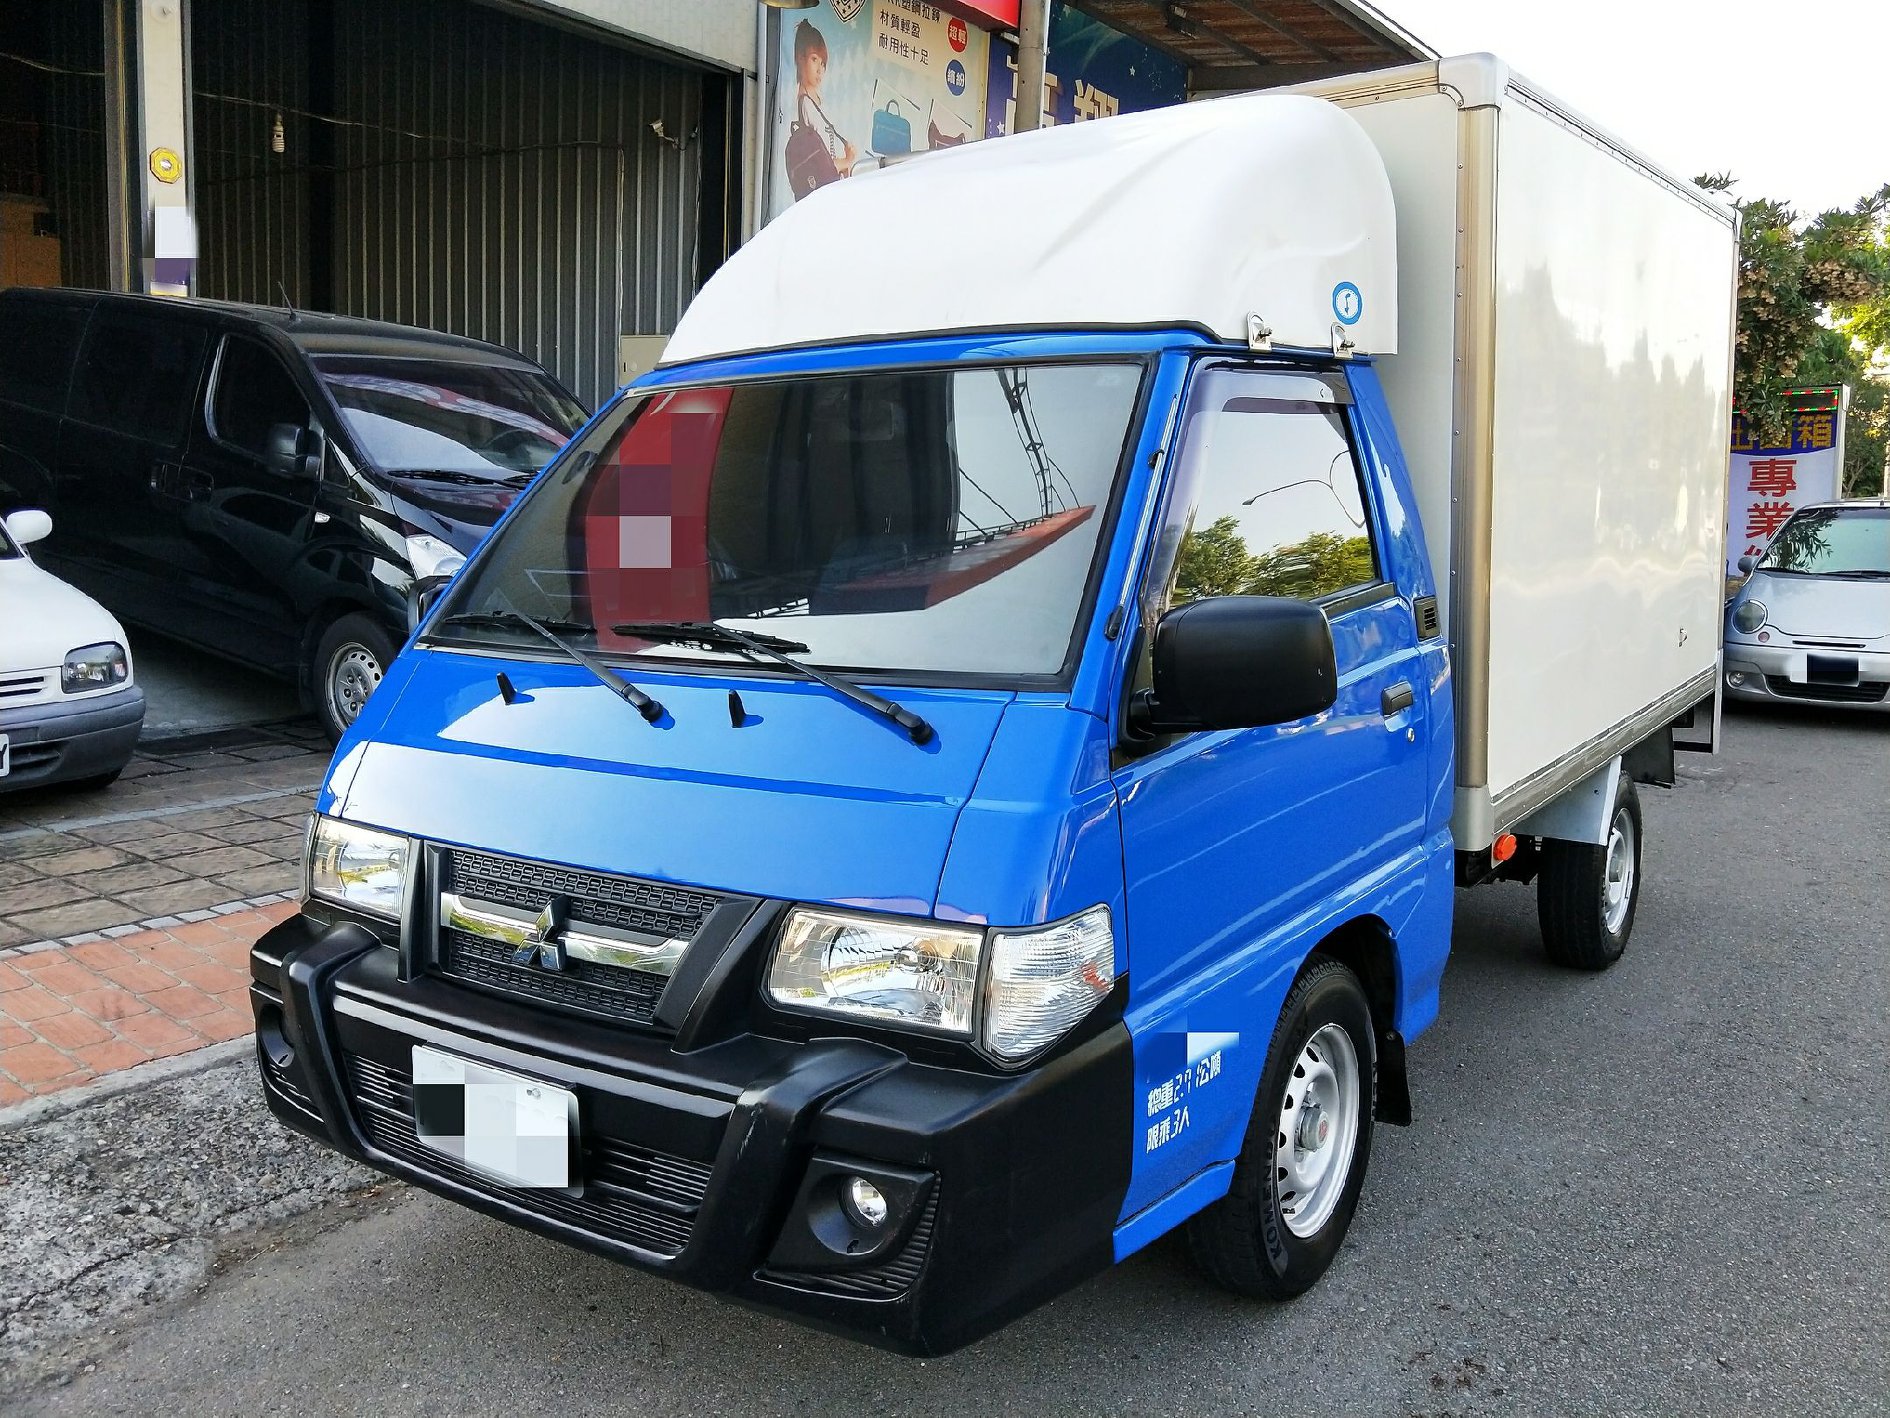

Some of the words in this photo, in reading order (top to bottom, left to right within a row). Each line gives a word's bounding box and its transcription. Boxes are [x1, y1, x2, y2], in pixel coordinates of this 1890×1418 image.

[879, 8, 921, 39] 材質輕盈
[878, 32, 930, 66] 耐用性十足
[1743, 458, 1798, 556] 專業
